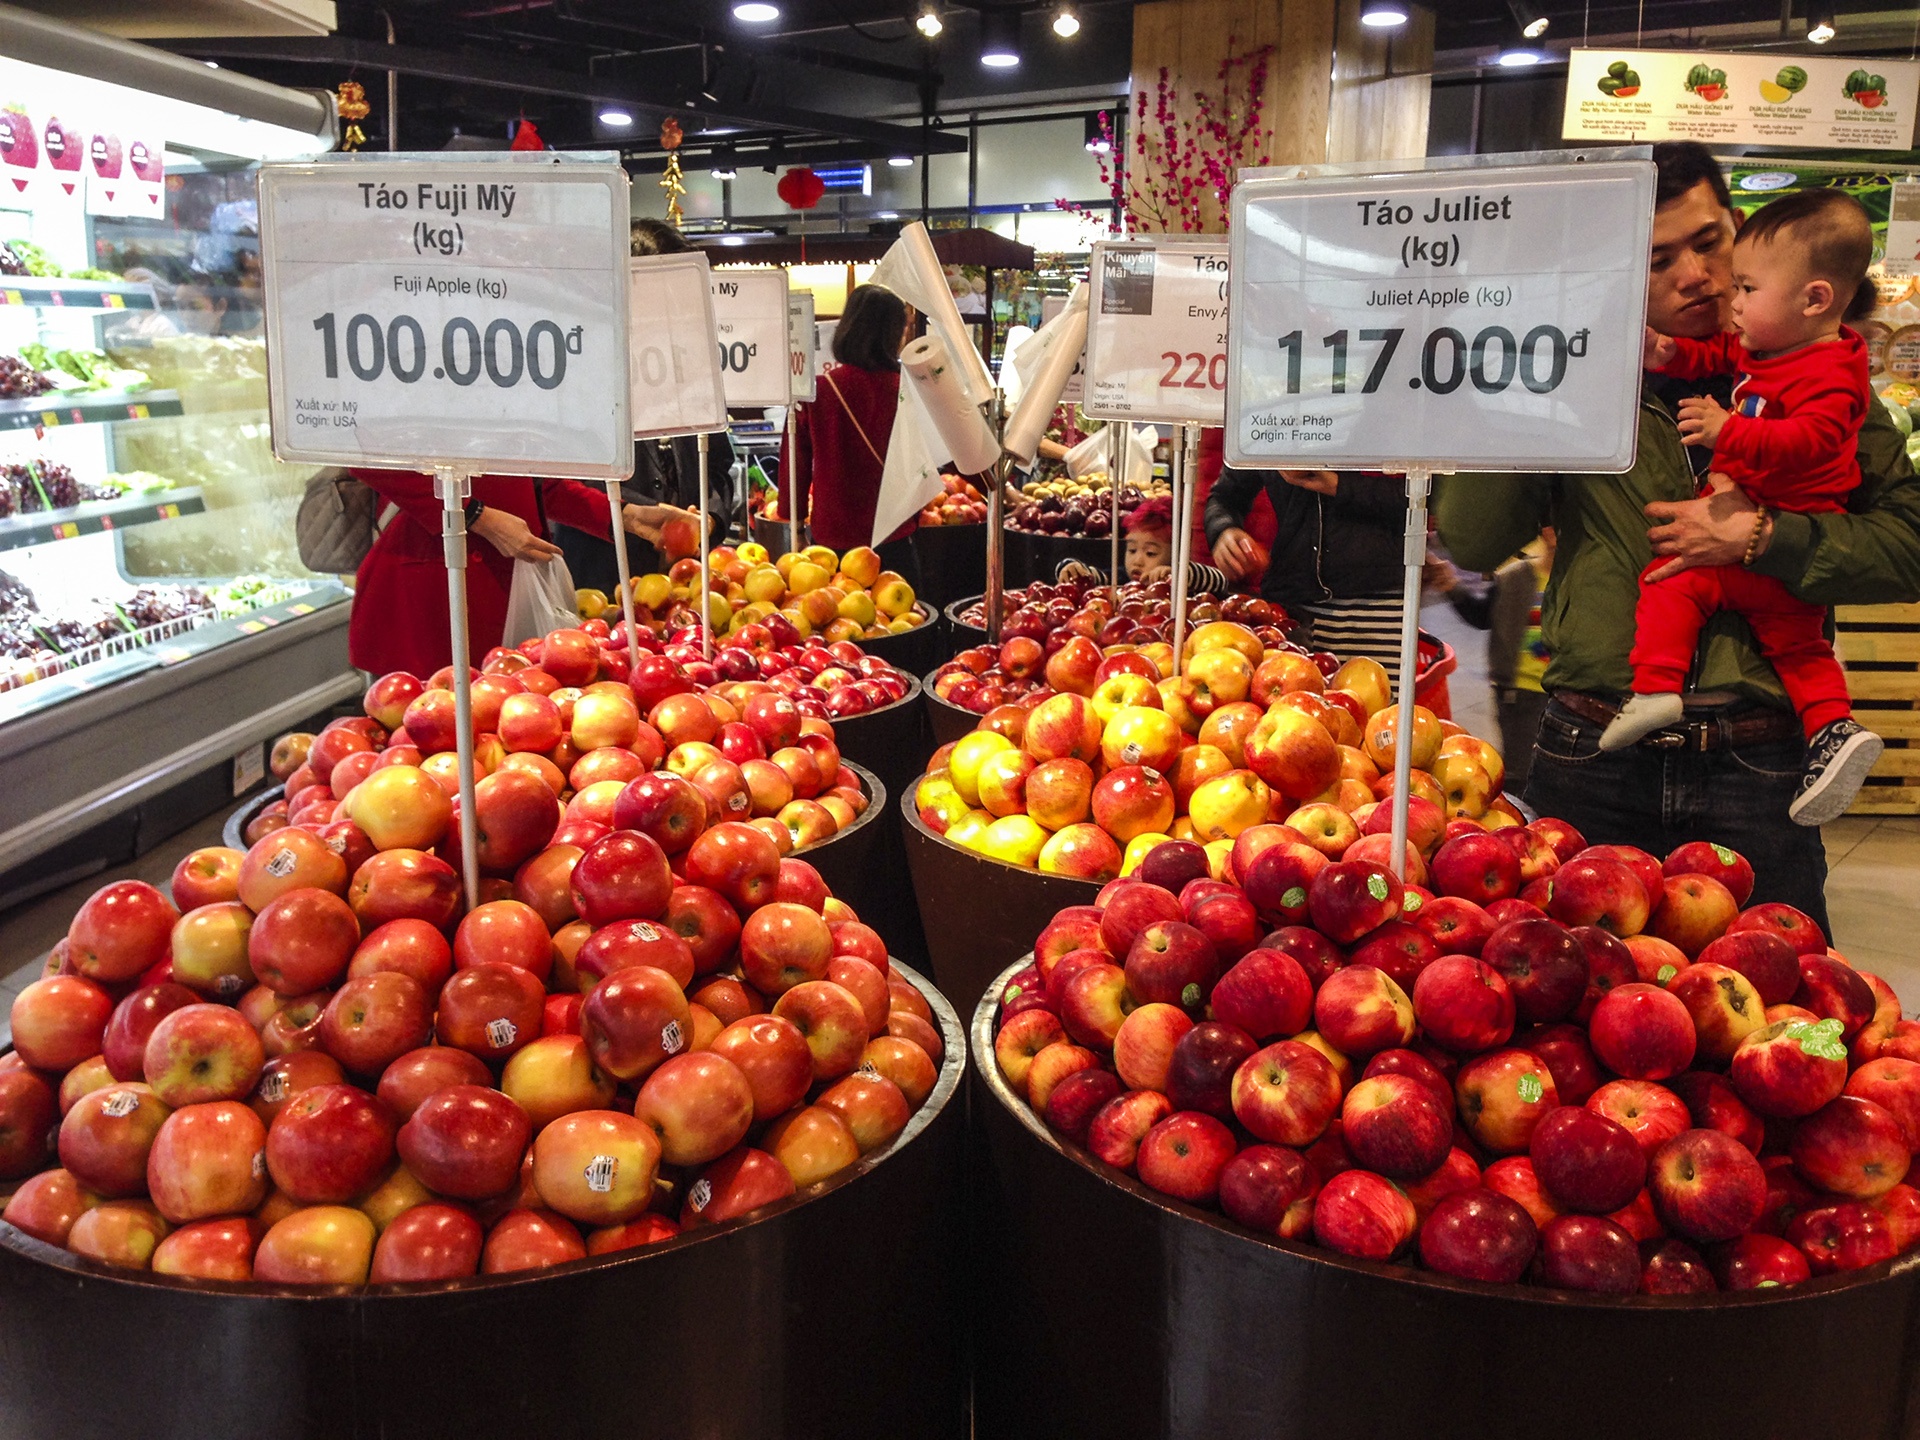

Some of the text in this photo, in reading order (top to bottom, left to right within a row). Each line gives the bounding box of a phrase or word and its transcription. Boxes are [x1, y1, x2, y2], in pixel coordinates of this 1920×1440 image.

[358, 182, 516, 218] Táo Fuji Mỹ
[1357, 195, 1512, 226] Táo Juliet
[413, 222, 464, 255] (kg)
[1401, 234, 1460, 268] (kg)
[1105, 267, 1127, 279] Mãi
[1193, 255, 1228, 273] Táo
[393, 276, 508, 299] Fuji Apple (kg)
[719, 282, 739, 298] Mỹ
[1366, 285, 1513, 308] Juliet Apple (kg)
[1188, 305, 1219, 321] Envy
[717, 324, 734, 334] (kg)
[313, 312, 584, 390] 100.000đ
[1278, 324, 1591, 395] 117.000đ
[295, 398, 320, 412] Xuất
[342, 401, 358, 415] Mỹ
[296, 413, 358, 428] Origin: USA
[1251, 414, 1334, 429] Xuất xứ: Pháp
[1250, 429, 1332, 443] Origin: France
